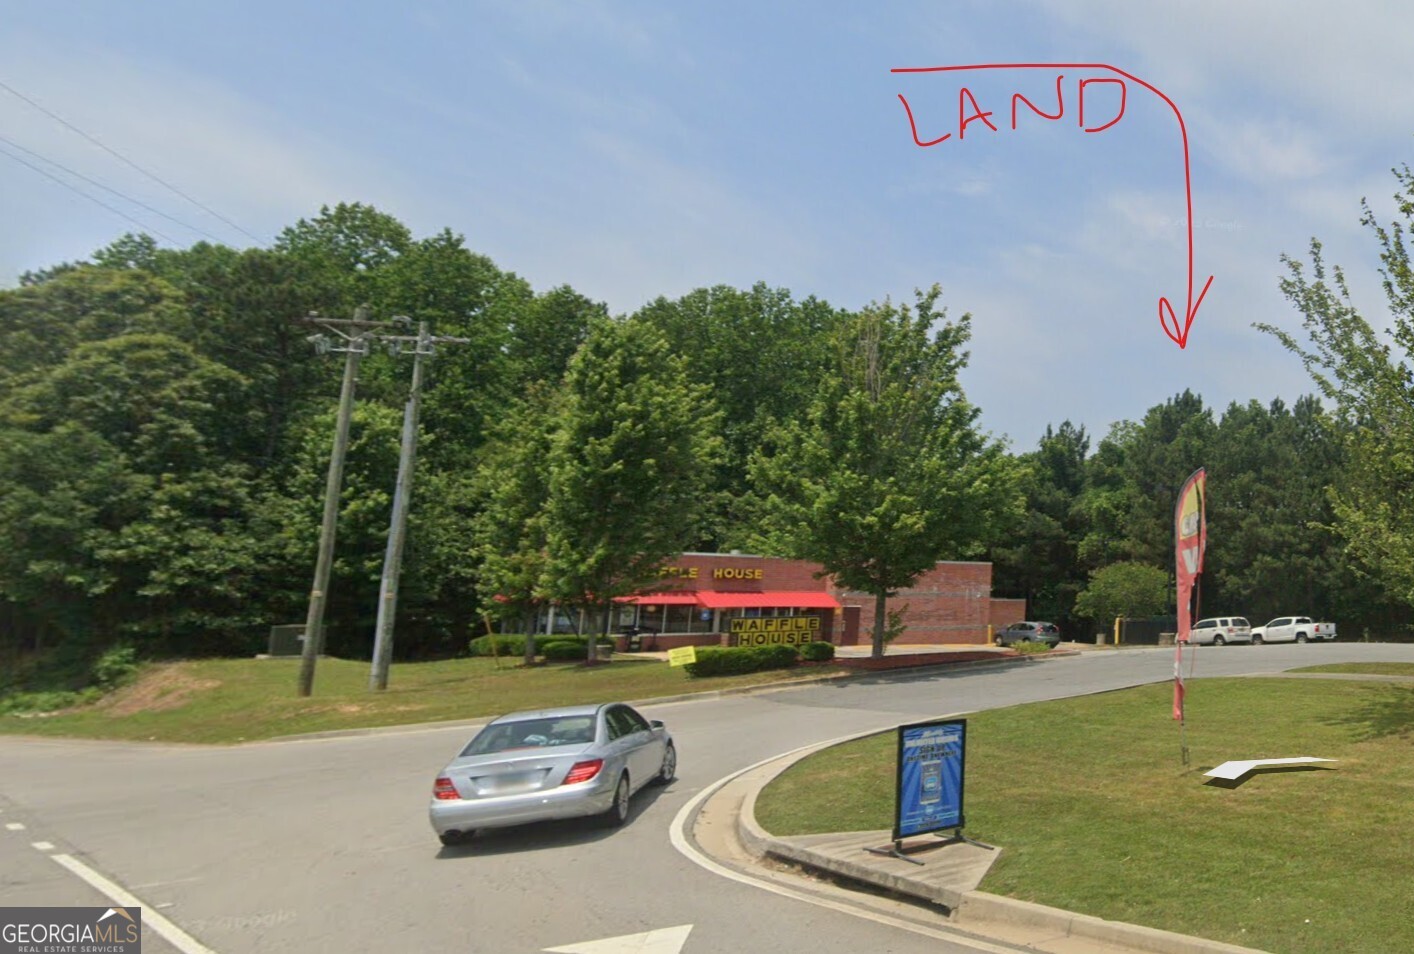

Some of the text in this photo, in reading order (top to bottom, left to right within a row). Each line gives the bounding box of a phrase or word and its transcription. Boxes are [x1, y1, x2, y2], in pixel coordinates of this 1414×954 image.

[898, 75, 1127, 147] LAND
[713, 567, 763, 580] HOUSE
[732, 618, 819, 631] WAFFLE
[739, 632, 811, 646] HOUSE
